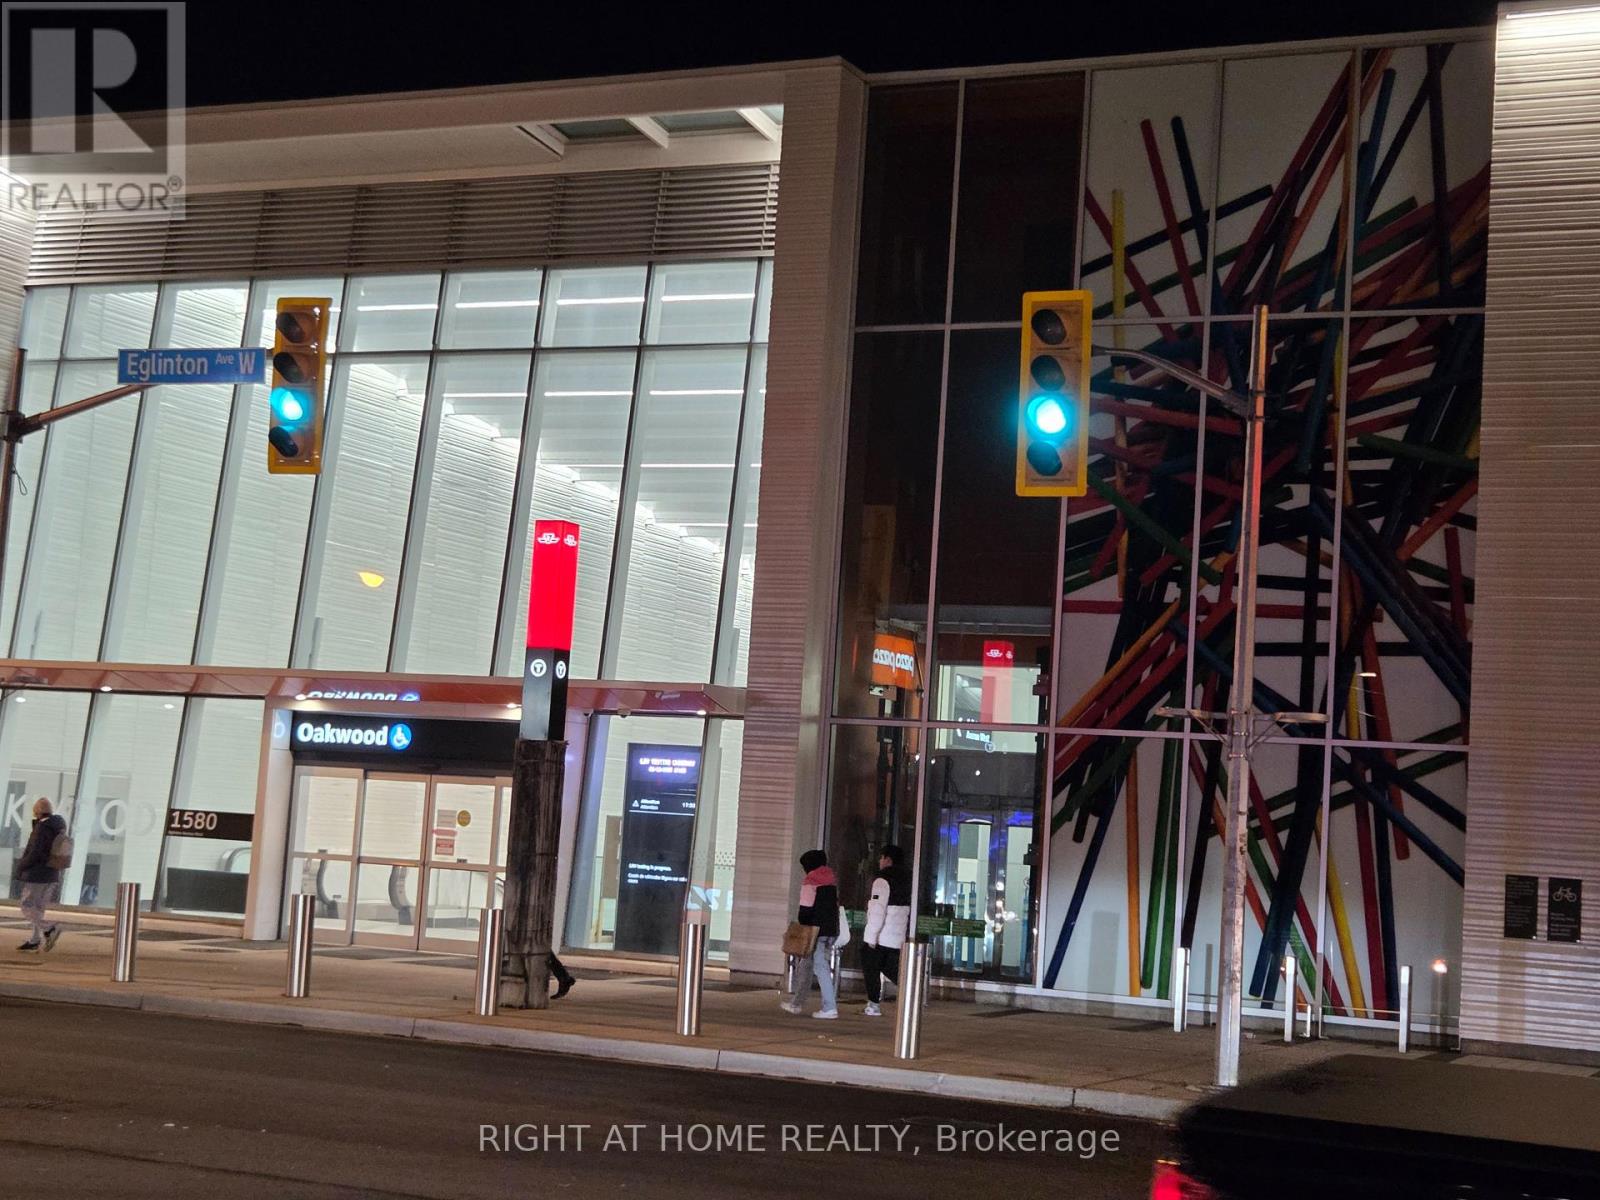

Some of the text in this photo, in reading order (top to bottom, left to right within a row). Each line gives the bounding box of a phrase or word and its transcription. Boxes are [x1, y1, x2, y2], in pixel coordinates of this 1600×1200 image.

[127, 351, 256, 382] Eglinton Ave W
[296, 722, 389, 746] Oakwood
[170, 810, 218, 831] 1580
